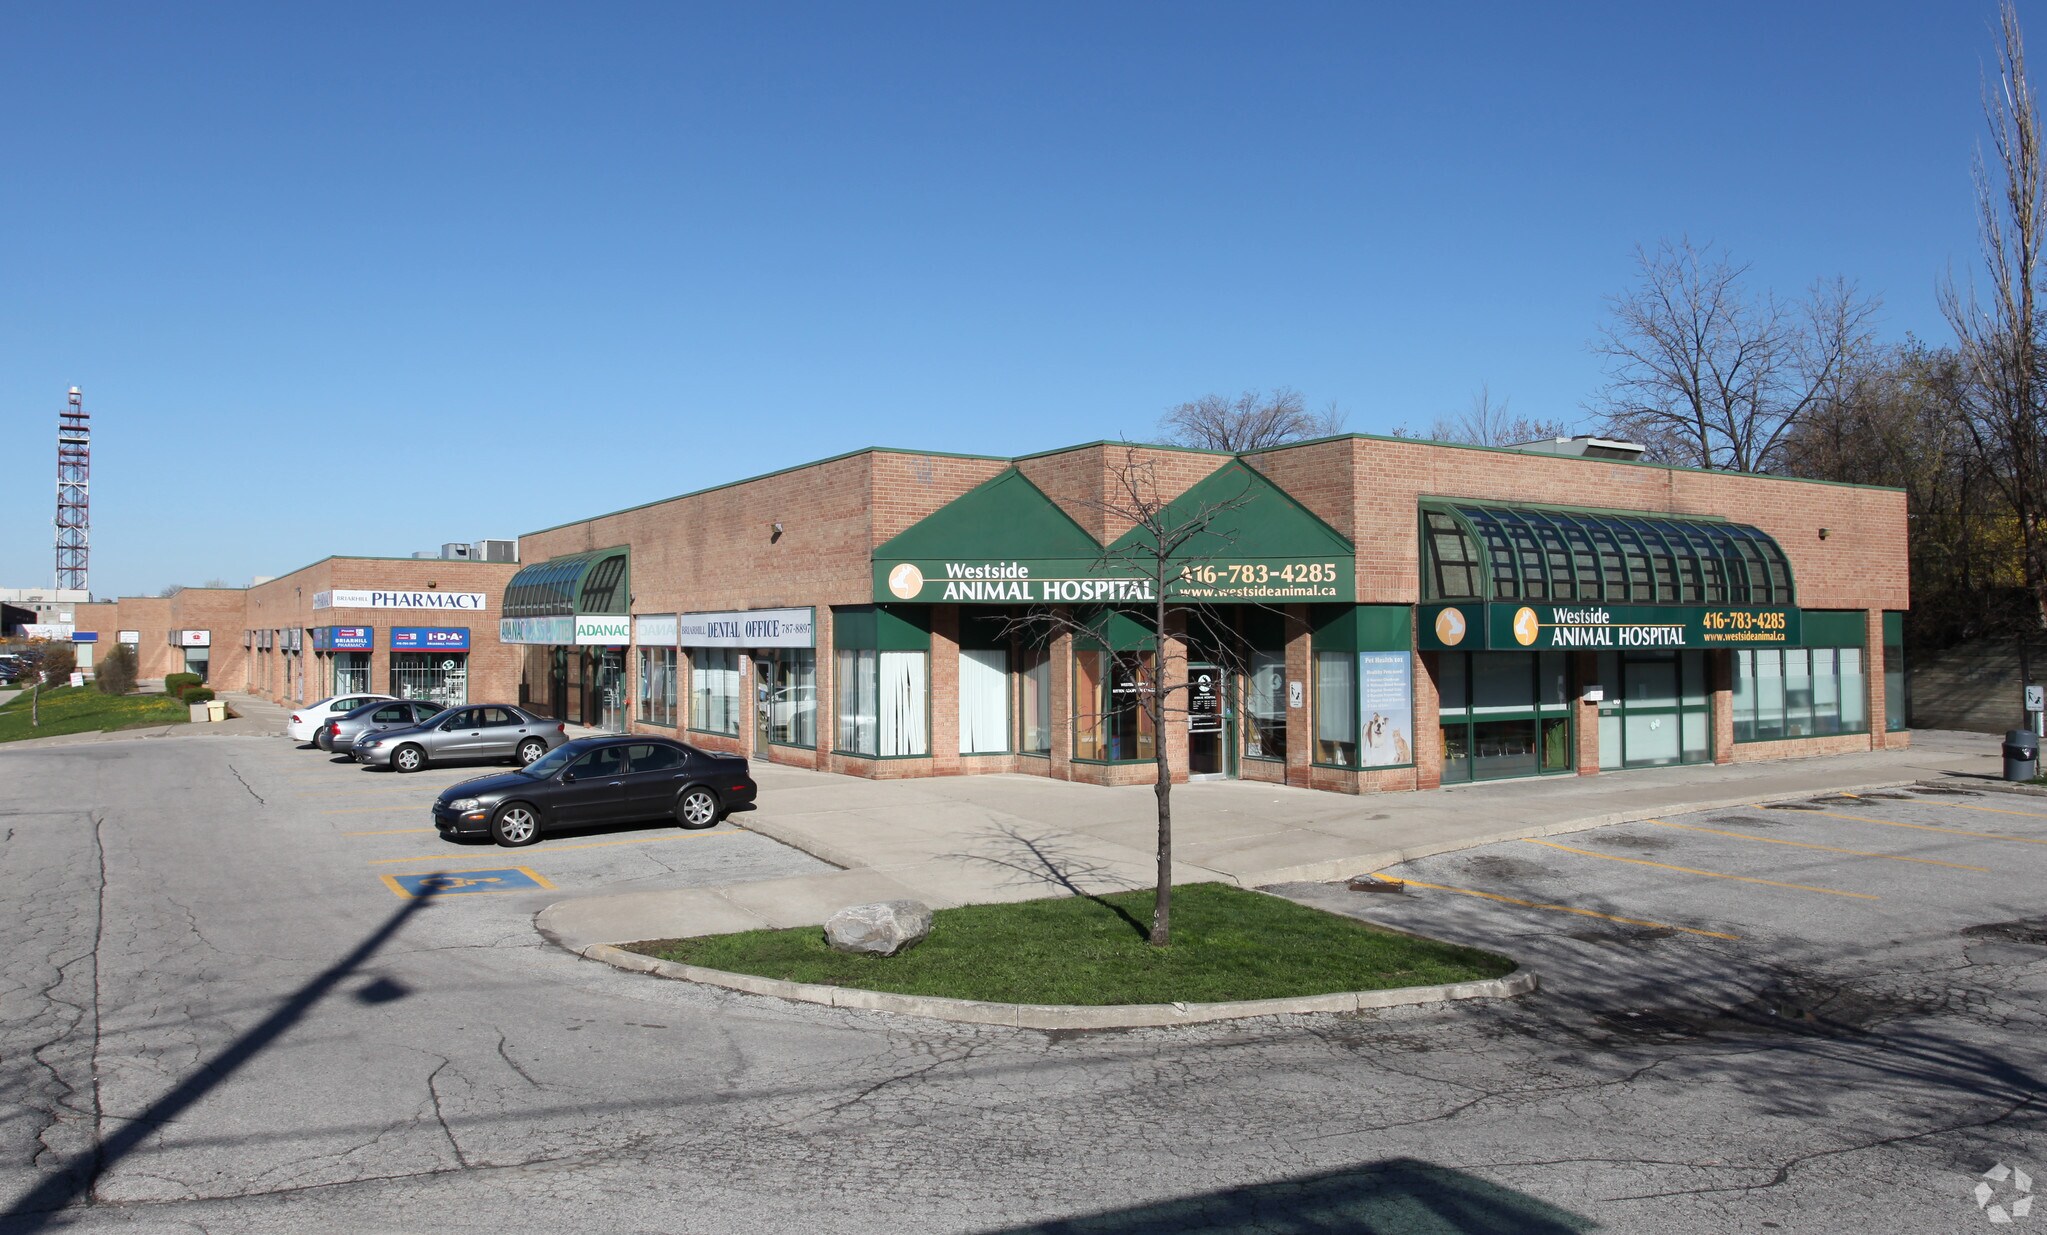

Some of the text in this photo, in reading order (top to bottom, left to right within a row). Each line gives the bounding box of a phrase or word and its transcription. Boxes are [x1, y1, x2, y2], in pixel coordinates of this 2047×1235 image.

[945, 562, 1029, 579] Westside
[1180, 563, 1337, 584] 416-783-4285
[942, 580, 1155, 600] ANIMAL HOSPITAL
[1180, 585, 1337, 598] www.westsideanimal.ca
[371, 592, 482, 608] PHARMACY
[1552, 607, 1610, 624] Westside
[1703, 612, 1785, 630] 416-783-4285
[577, 624, 629, 637] ADANAC
[707, 621, 741, 638] DENTAL
[745, 620, 780, 638] OFFICE
[781, 623, 811, 634] 787-8897
[1551, 626, 1686, 646] ANIMAL HOSPITAL
[1703, 630, 1785, 642] www.westsideanimal.ca
